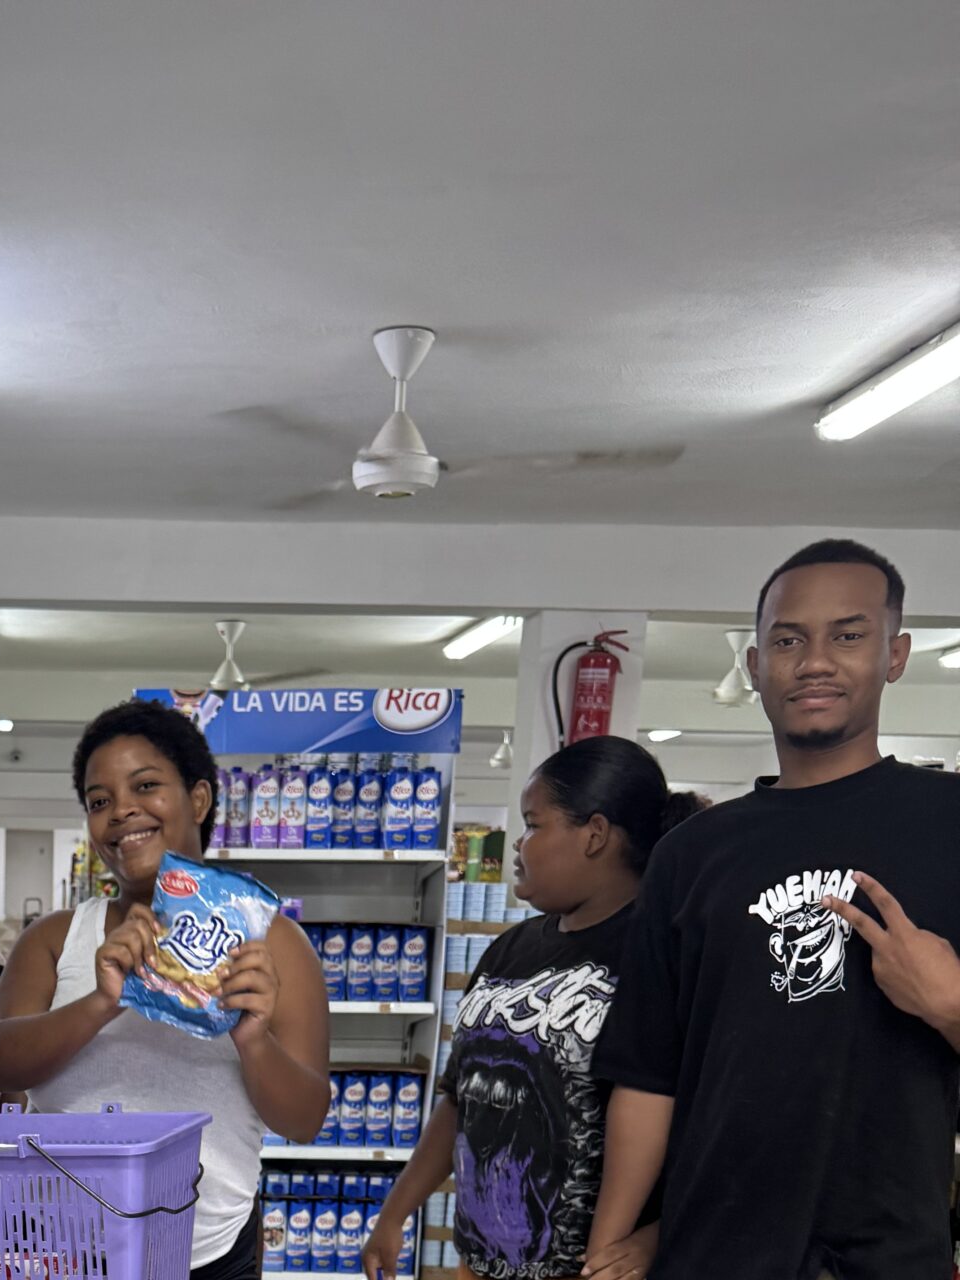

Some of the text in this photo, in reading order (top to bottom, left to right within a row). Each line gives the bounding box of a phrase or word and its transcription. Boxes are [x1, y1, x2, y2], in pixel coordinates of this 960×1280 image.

[232, 688, 441, 714] LA VIDA ES Rica
[490, 1258, 515, 1279] Do
